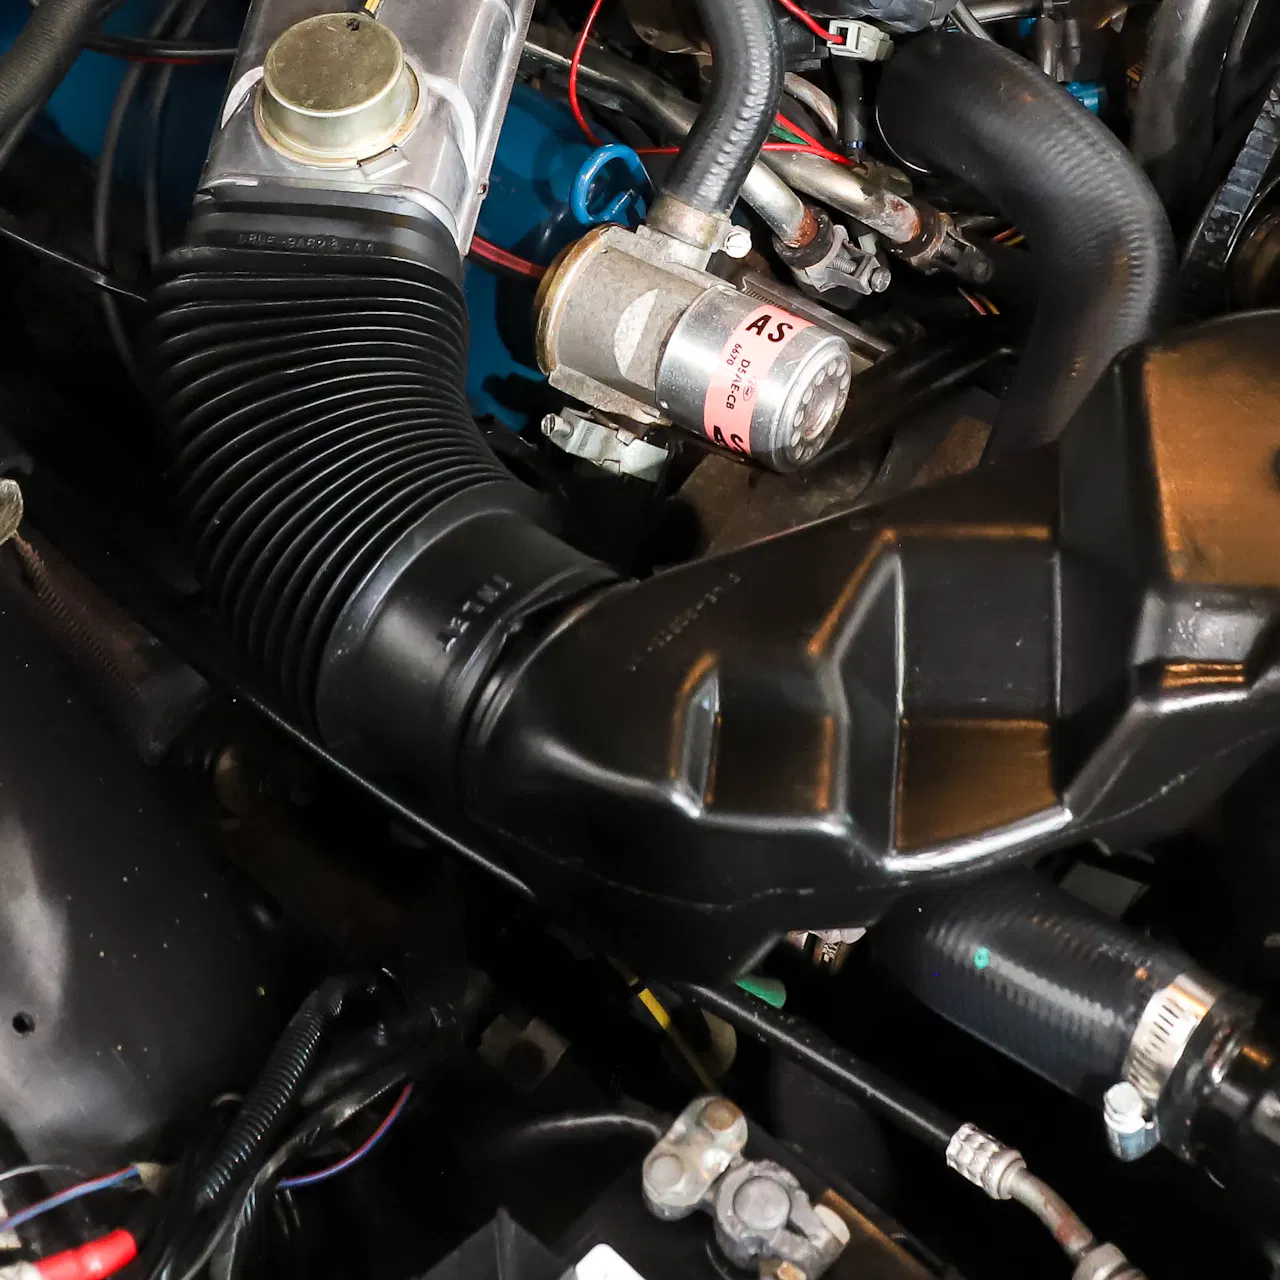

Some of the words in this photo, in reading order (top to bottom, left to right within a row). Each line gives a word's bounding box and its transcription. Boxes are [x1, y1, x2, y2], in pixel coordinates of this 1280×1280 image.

[745, 314, 794, 343] AS
[727, 343, 742, 365] 6670
[713, 425, 746, 453] AS
